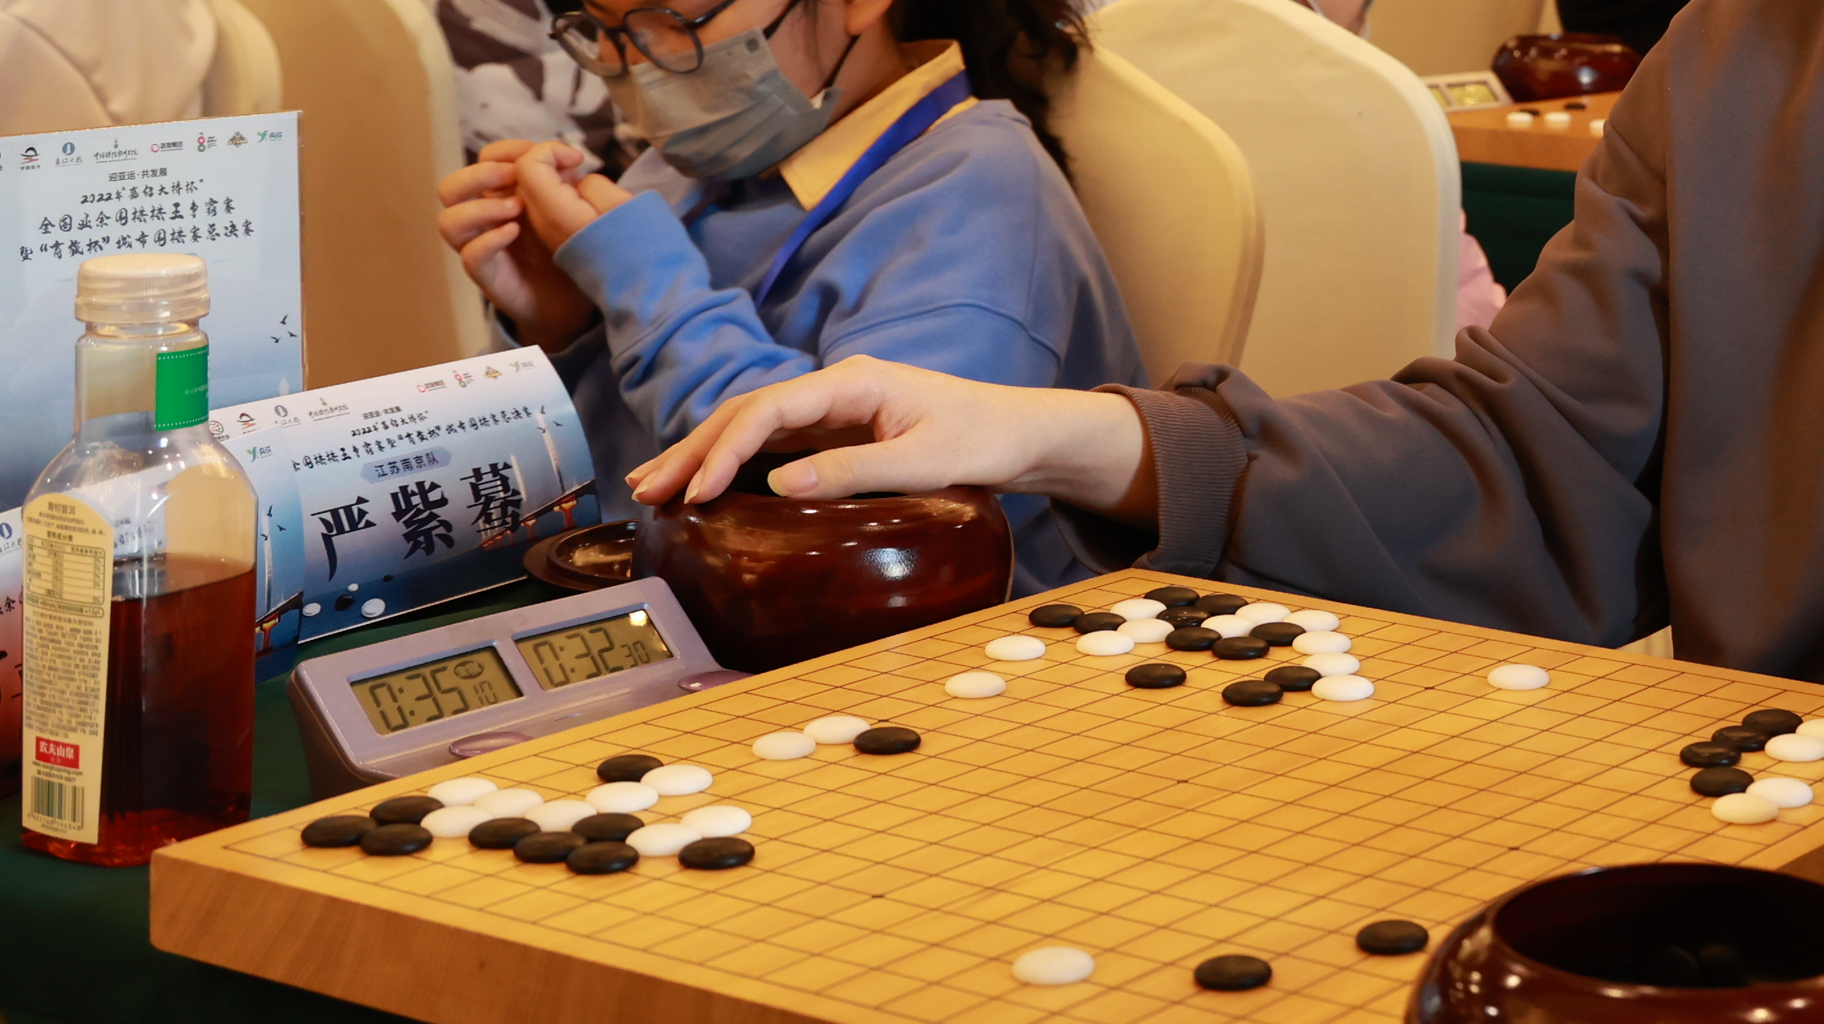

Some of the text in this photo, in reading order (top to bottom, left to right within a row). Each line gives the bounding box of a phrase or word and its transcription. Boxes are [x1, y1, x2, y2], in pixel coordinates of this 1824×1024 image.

[108, 168, 167, 182] 迎亚运·共发展
[375, 451, 440, 478] 江苏南京队
[532, 627, 625, 688] 0:32
[369, 666, 470, 733] 0:35
[473, 680, 498, 707] 10
